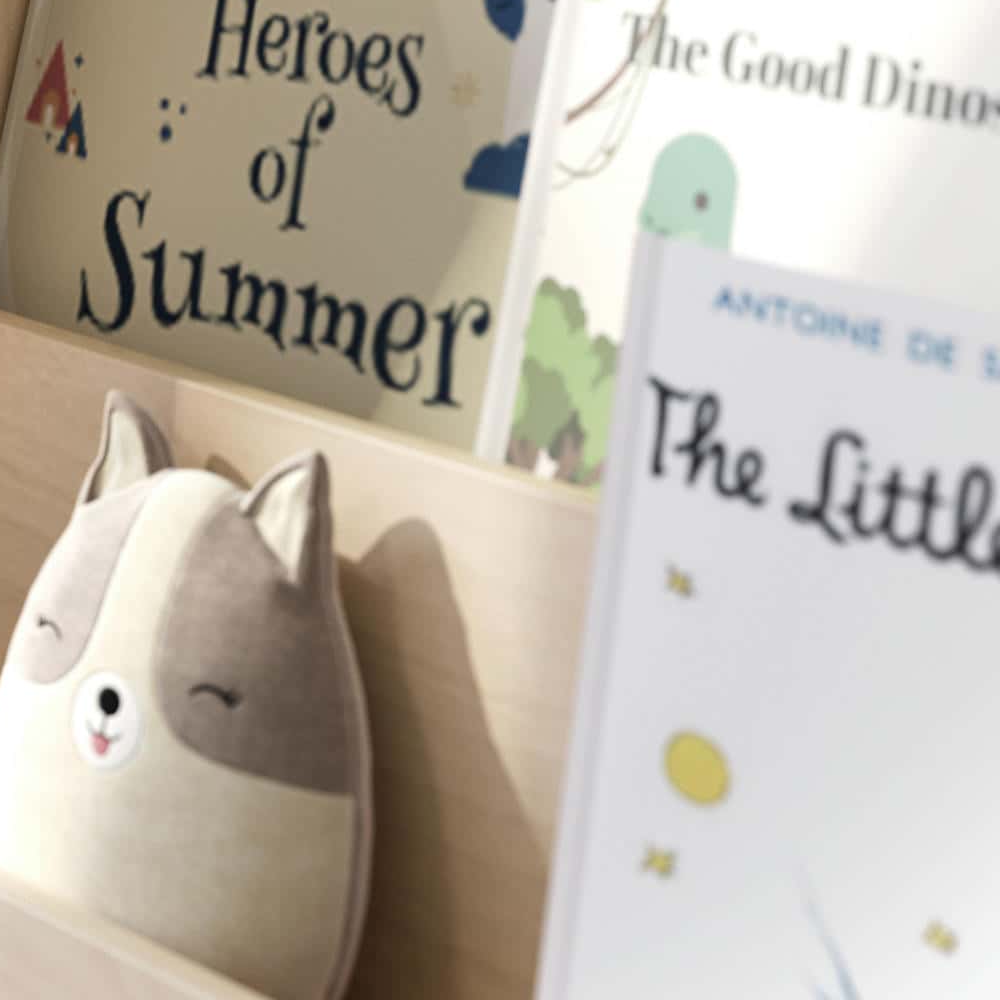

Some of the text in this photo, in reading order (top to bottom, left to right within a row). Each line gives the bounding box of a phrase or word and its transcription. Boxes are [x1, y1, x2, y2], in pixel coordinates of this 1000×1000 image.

[622, 10, 1000, 126] The Good Dino
[249, 95, 335, 231] of
[77, 190, 491, 407] Summer
[714, 284, 884, 354] ANTOINE
[906, 327, 957, 371] DE
[648, 375, 766, 506] The
